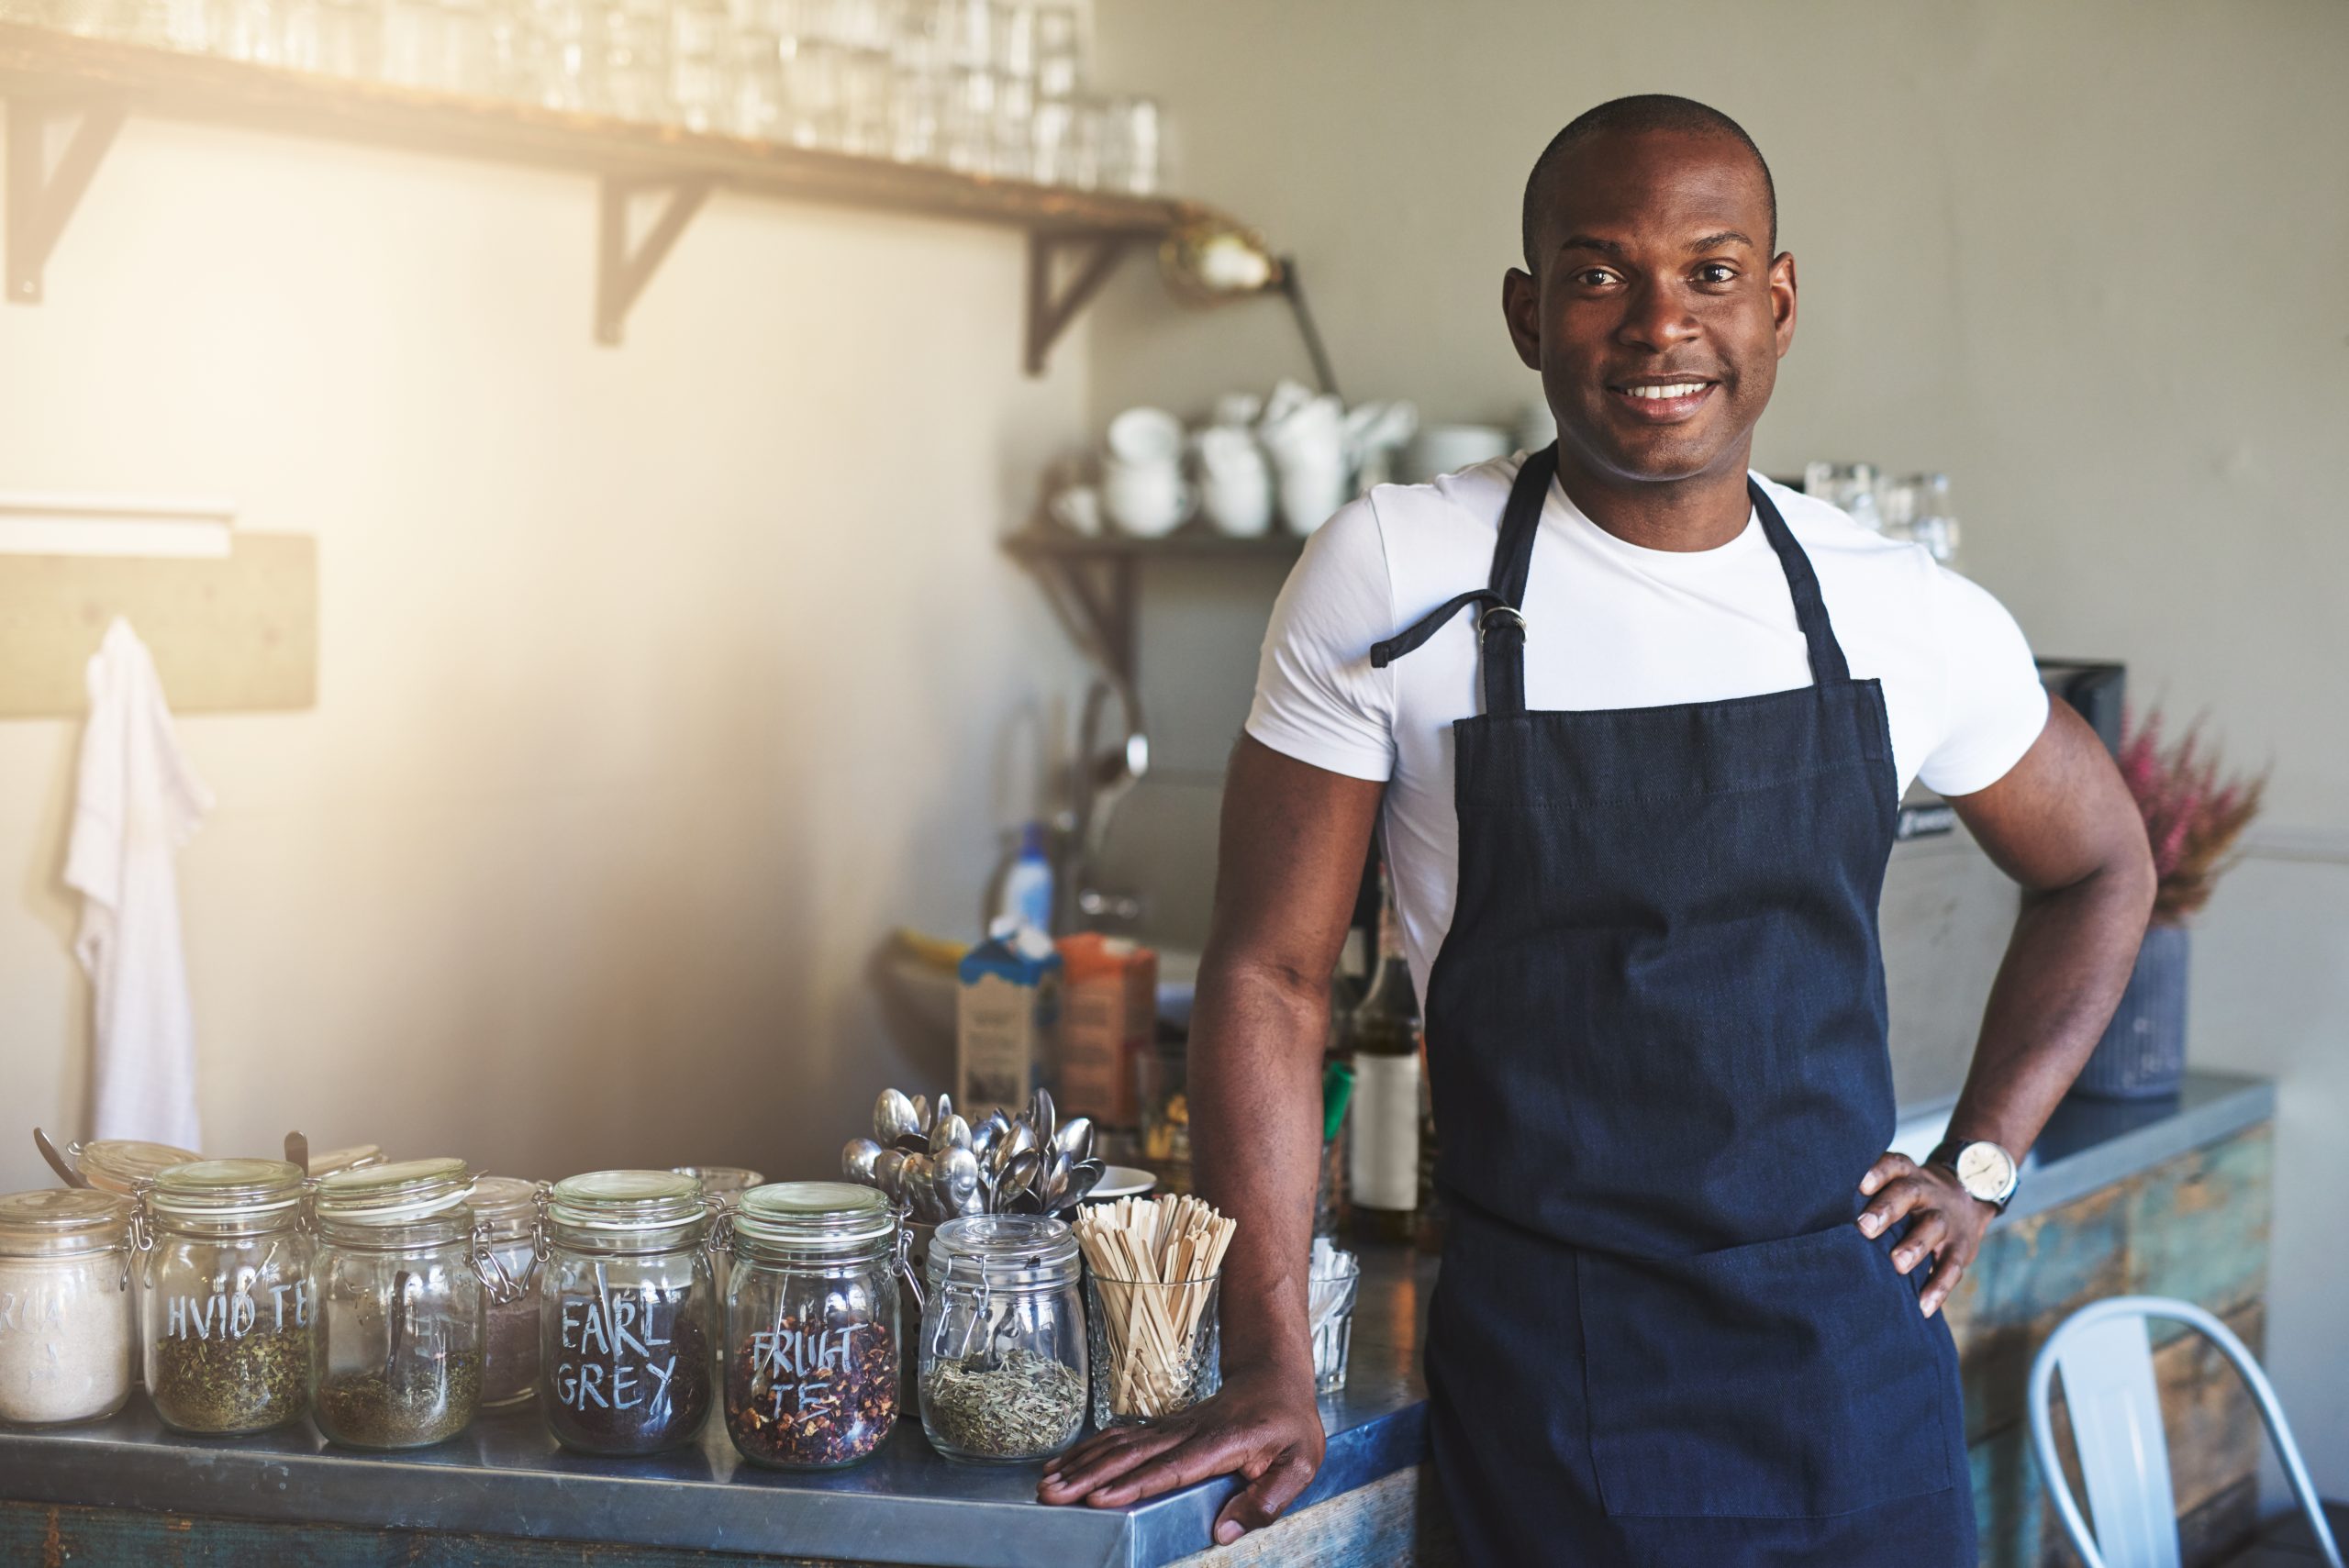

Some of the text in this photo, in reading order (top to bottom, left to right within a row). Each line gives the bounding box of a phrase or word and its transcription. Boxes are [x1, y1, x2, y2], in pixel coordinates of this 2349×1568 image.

[168, 1295, 255, 1341] HVID
[562, 1293, 671, 1357] EARL
[557, 1355, 676, 1415] GREY
[771, 1383, 832, 1423] TE
